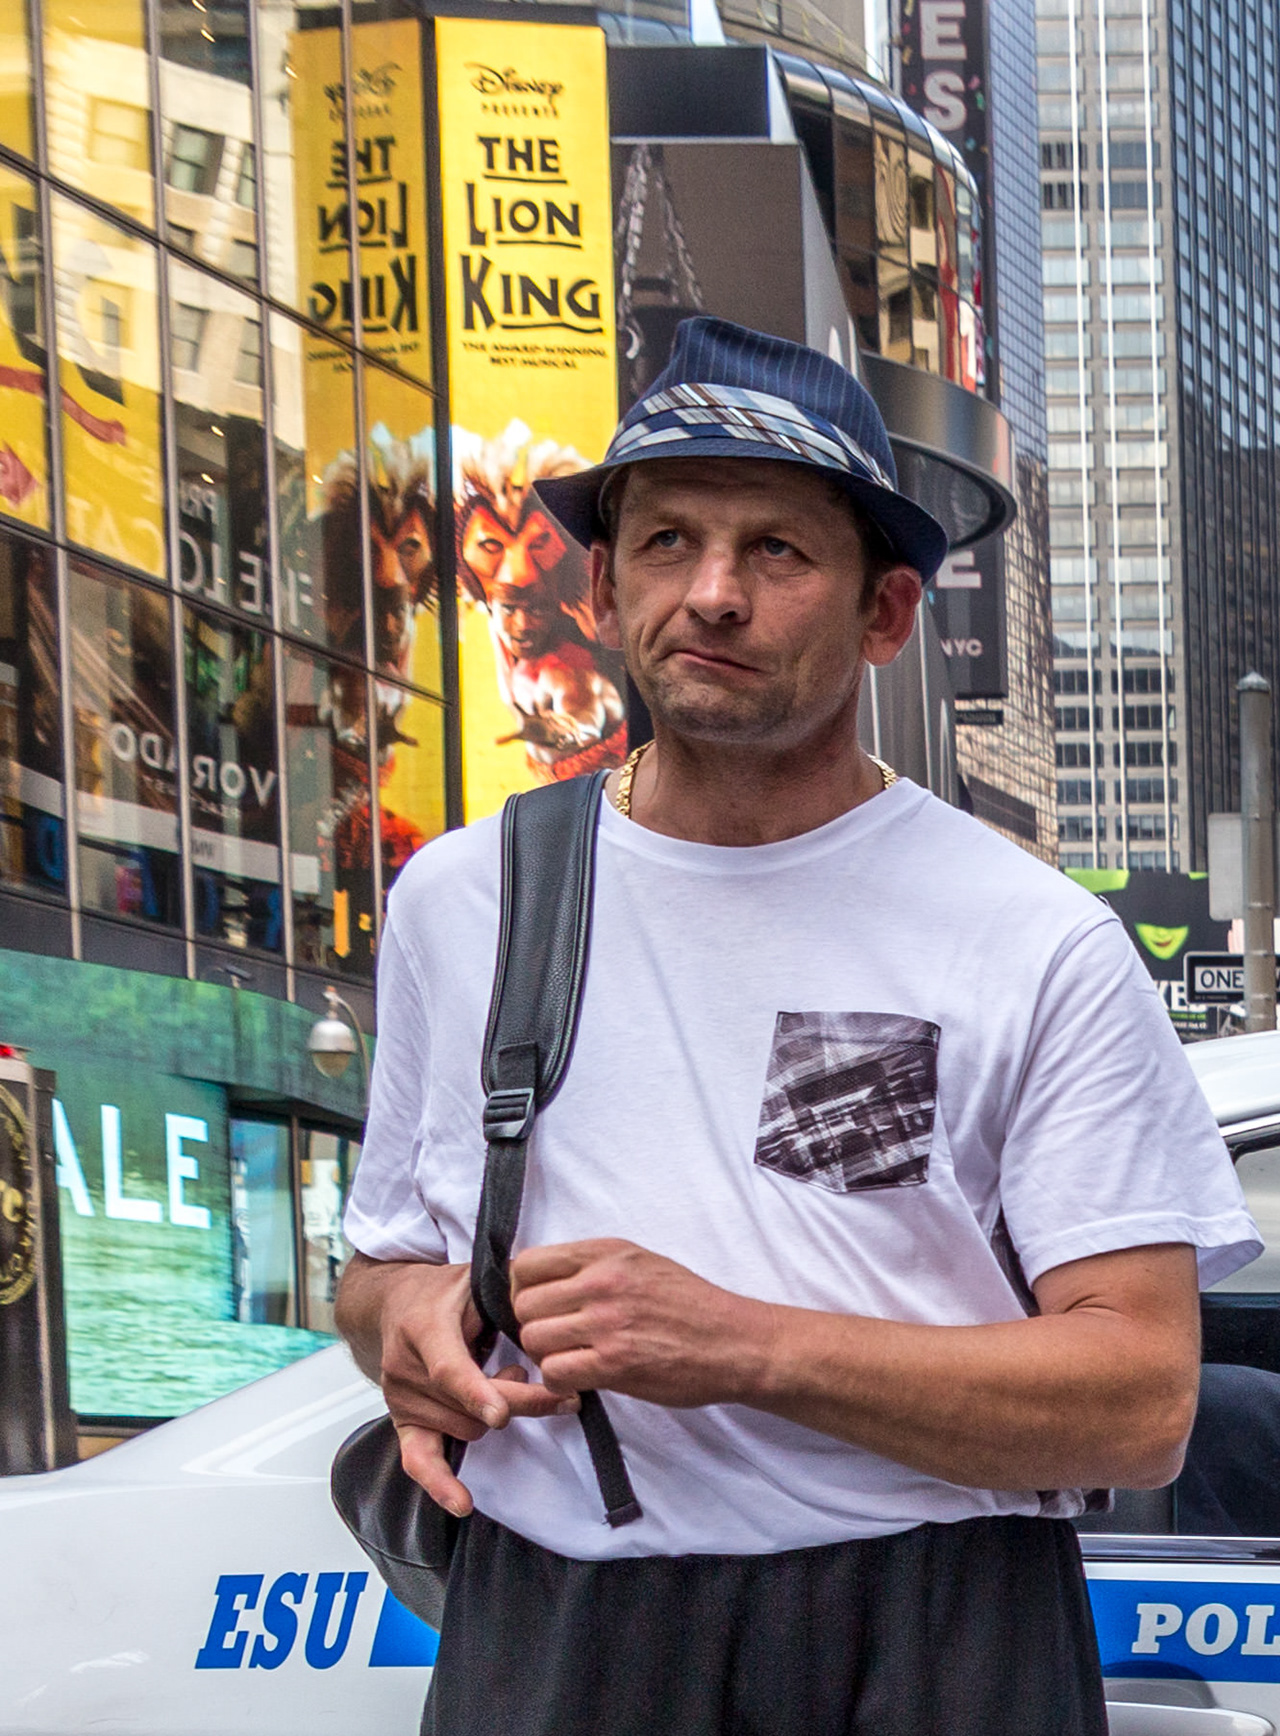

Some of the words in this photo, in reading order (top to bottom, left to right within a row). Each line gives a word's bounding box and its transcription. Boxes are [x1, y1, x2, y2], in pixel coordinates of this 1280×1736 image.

[464, 61, 565, 104] Disney
[477, 135, 560, 174] THE
[465, 181, 581, 247] LION
[460, 254, 602, 331] KING
[1200, 970, 1244, 989] ONE
[194, 1571, 369, 1670] ESU
